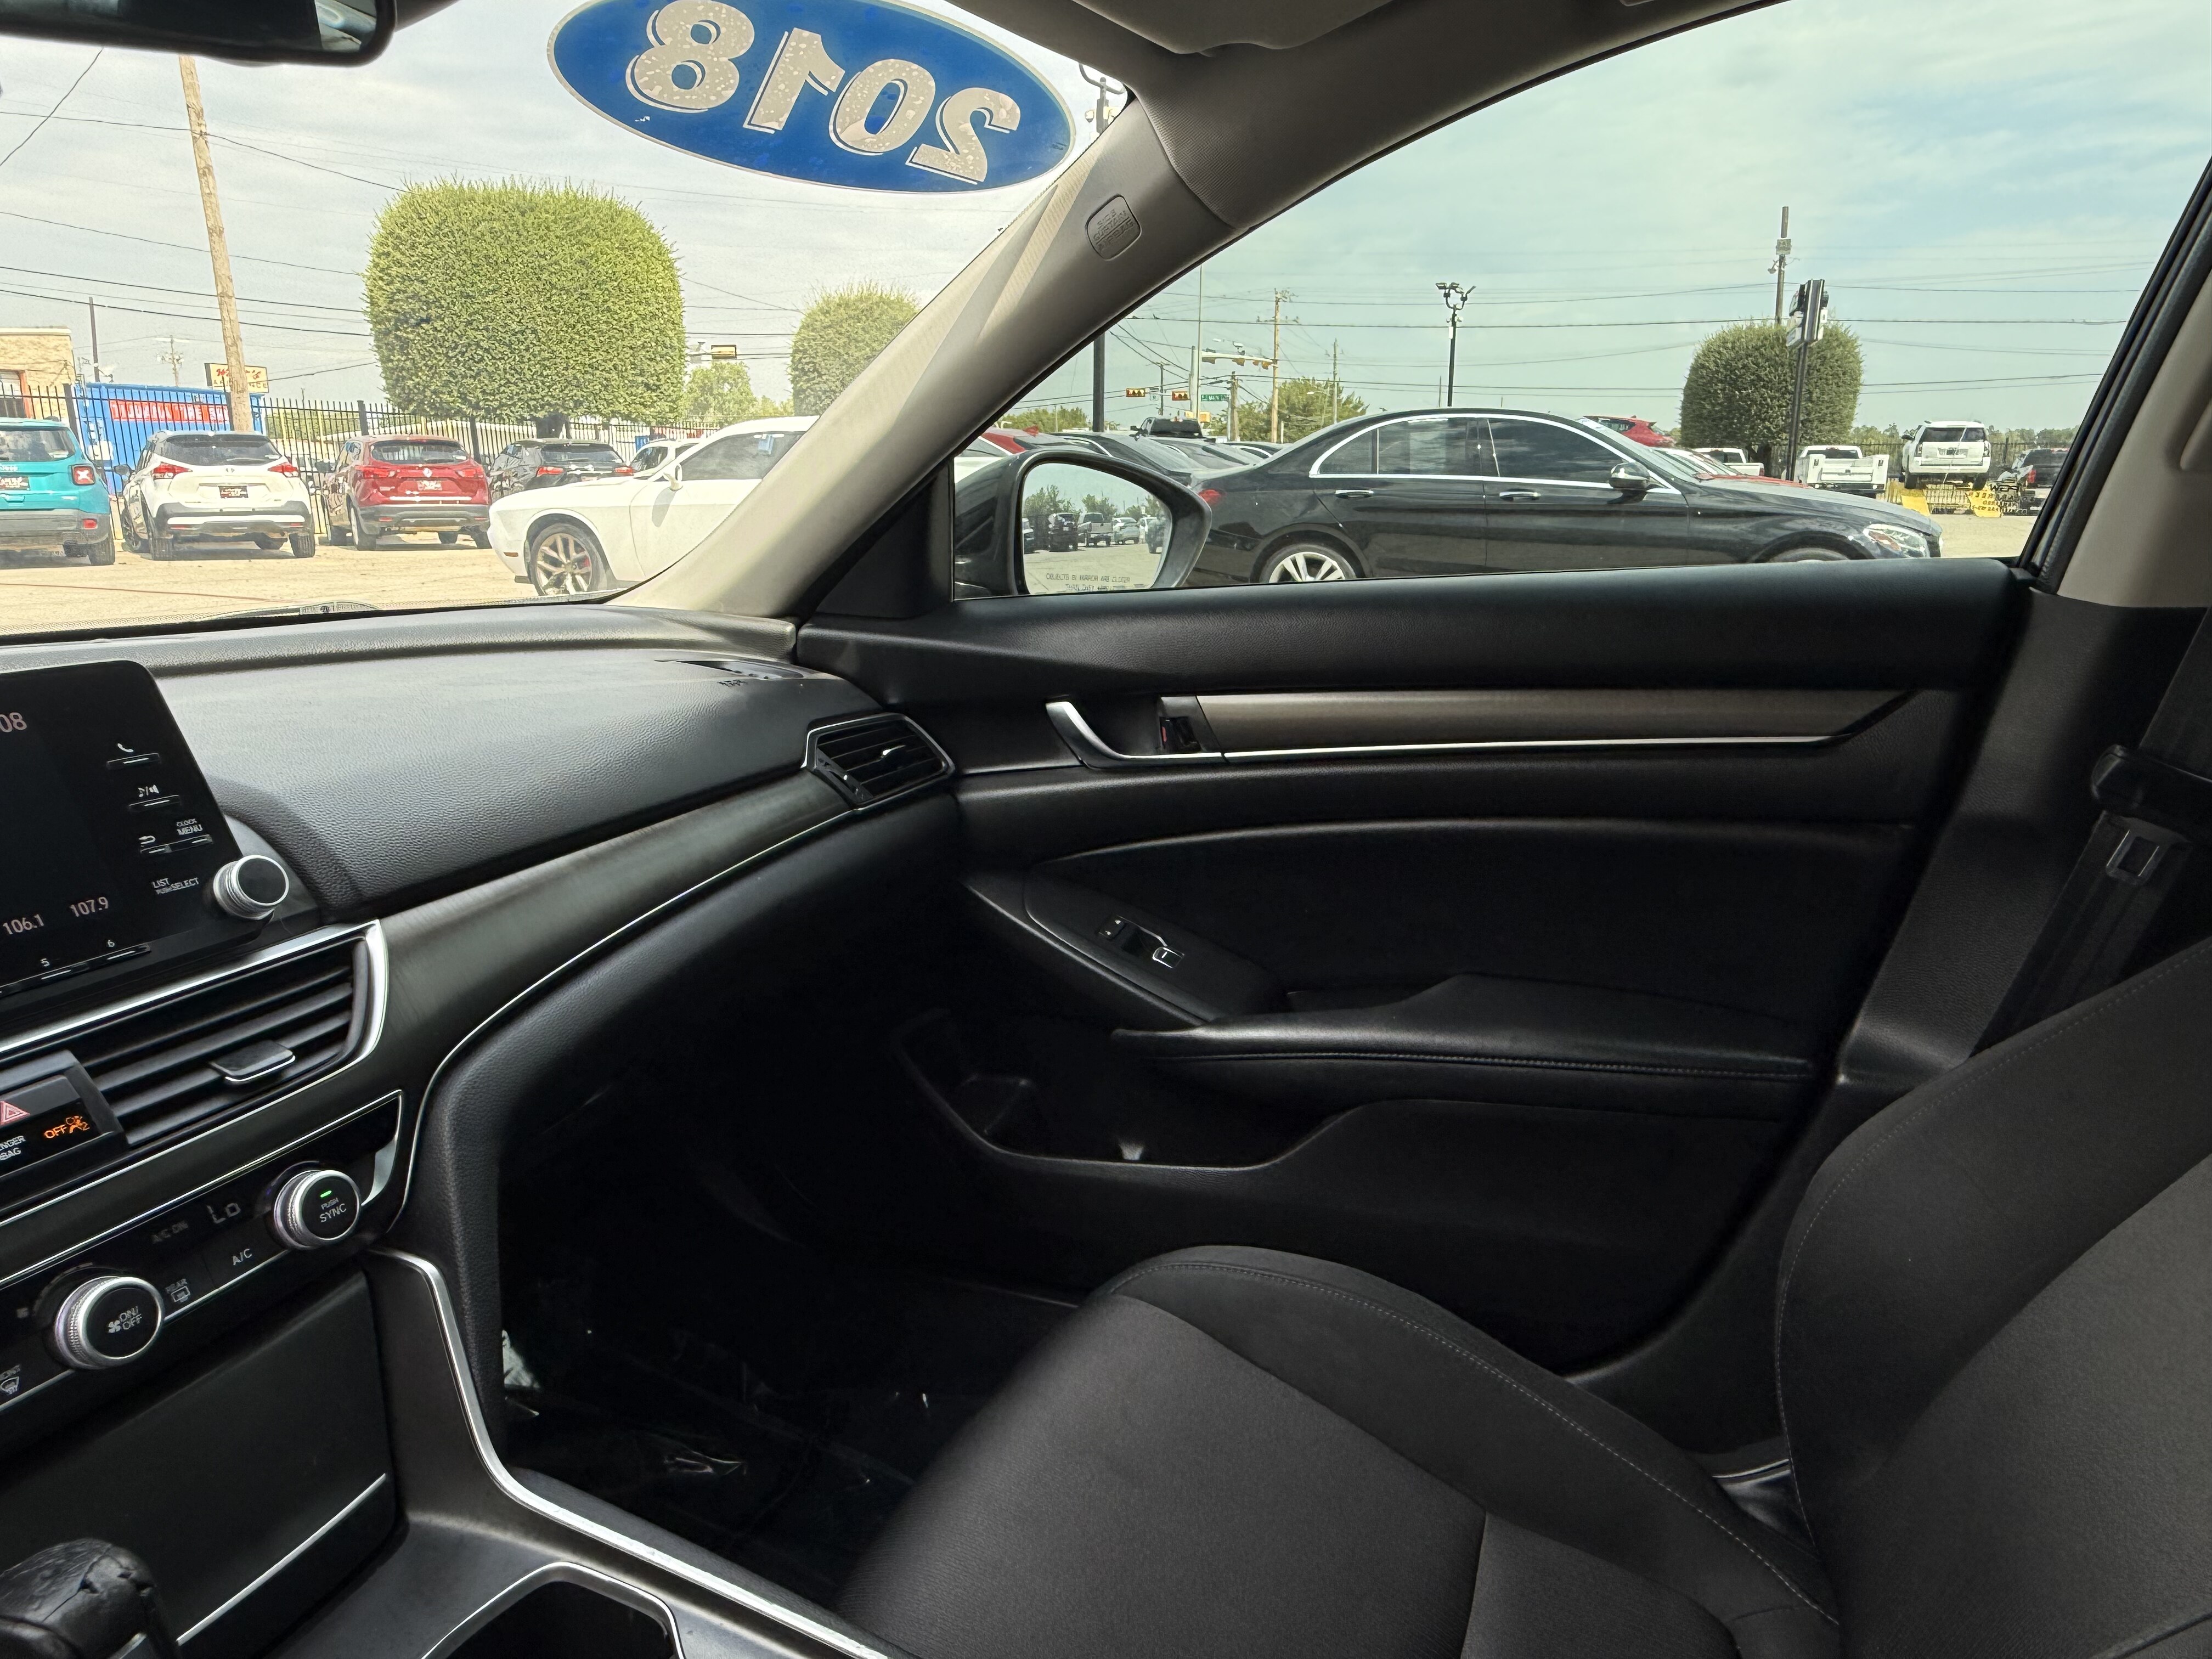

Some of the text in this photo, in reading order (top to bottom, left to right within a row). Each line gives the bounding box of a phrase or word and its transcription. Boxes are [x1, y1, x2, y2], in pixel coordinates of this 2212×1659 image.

[177, 824, 203, 835] MENU
[152, 878, 170, 888] LIST
[3, 896, 109, 935] 106.1 107.9
[41, 958, 50, 967] 5
[44, 1124, 67, 1138] OFF
[320, 1203, 347, 1222] SYNC
[233, 1249, 252, 1266] A/C
[123, 1313, 142, 1330] OFF
